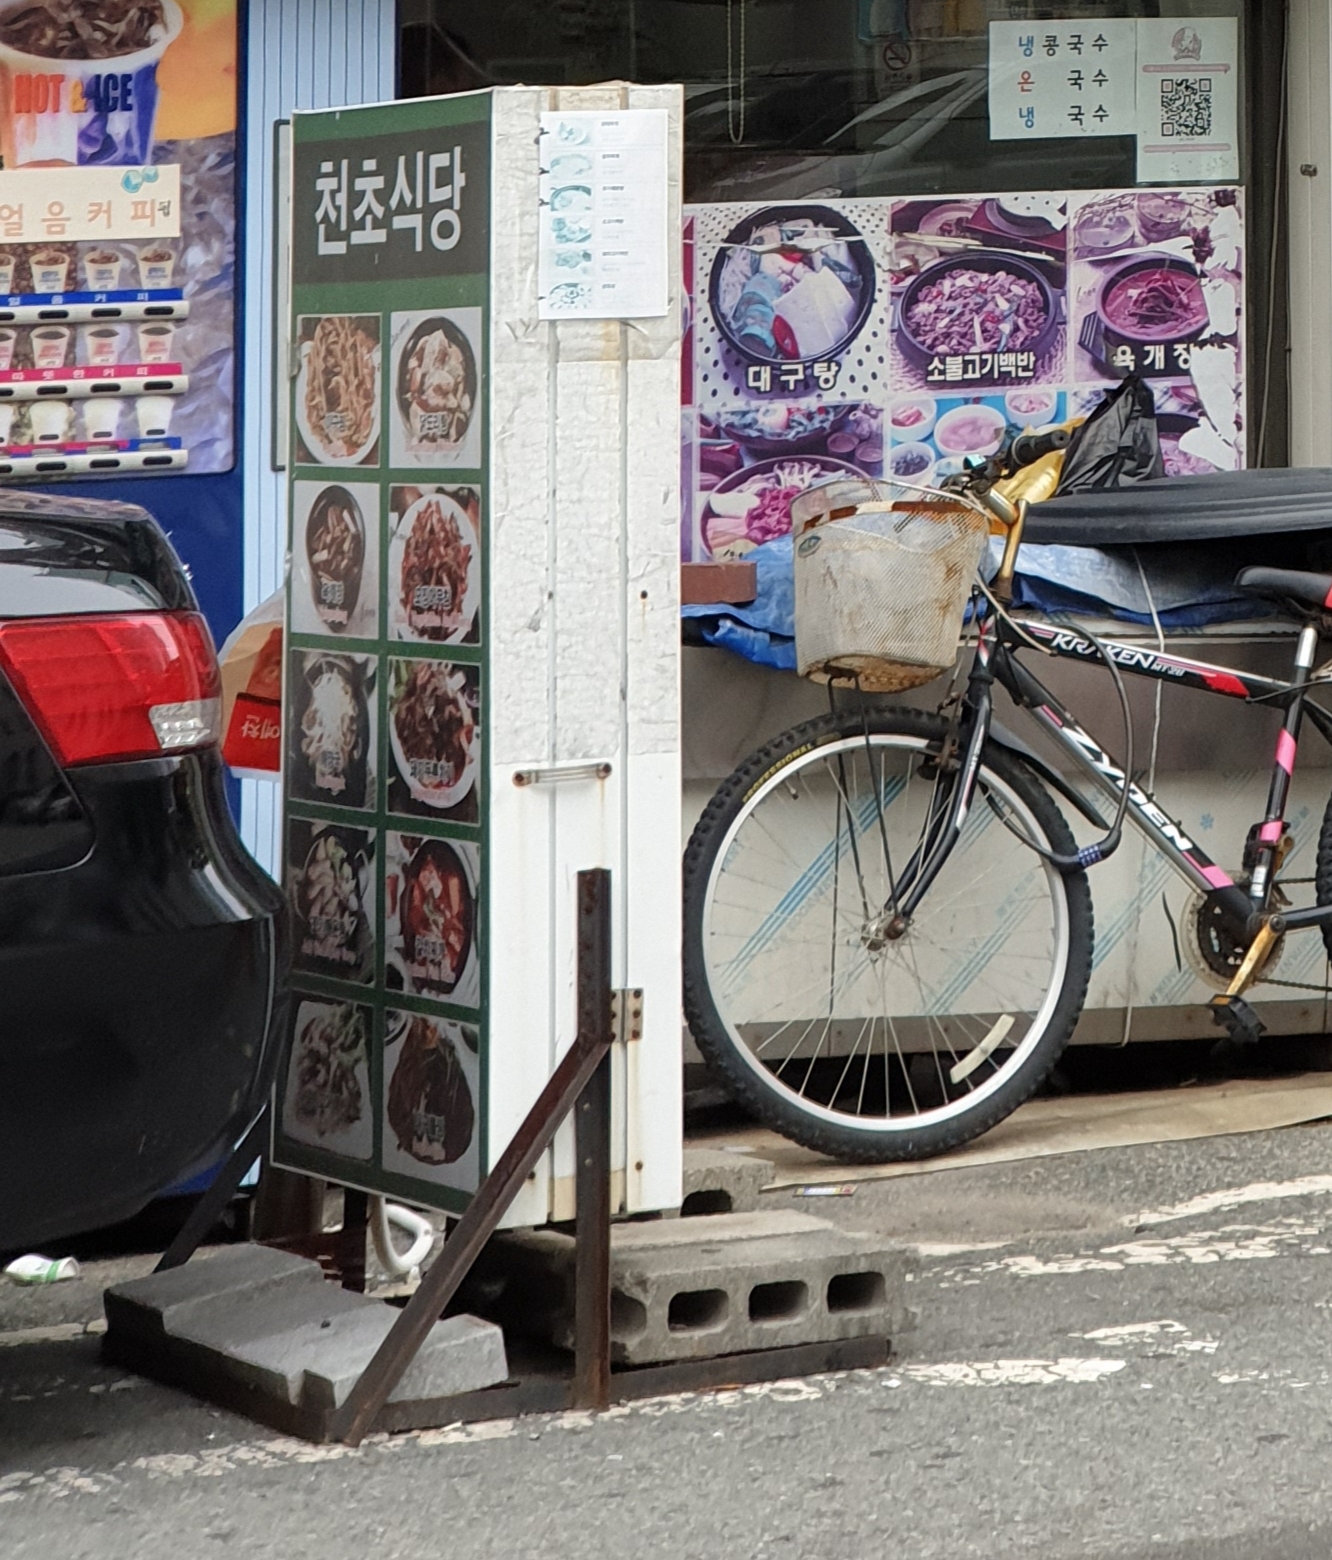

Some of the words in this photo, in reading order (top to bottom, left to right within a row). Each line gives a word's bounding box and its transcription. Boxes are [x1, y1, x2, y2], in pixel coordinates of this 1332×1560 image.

[14, 73, 65, 114] HOT
[94, 73, 134, 113] ICE
[314, 144, 467, 256] 천초식당
[745, 360, 840, 393] 대구탕
[926, 351, 1037, 383] 소불고기백반
